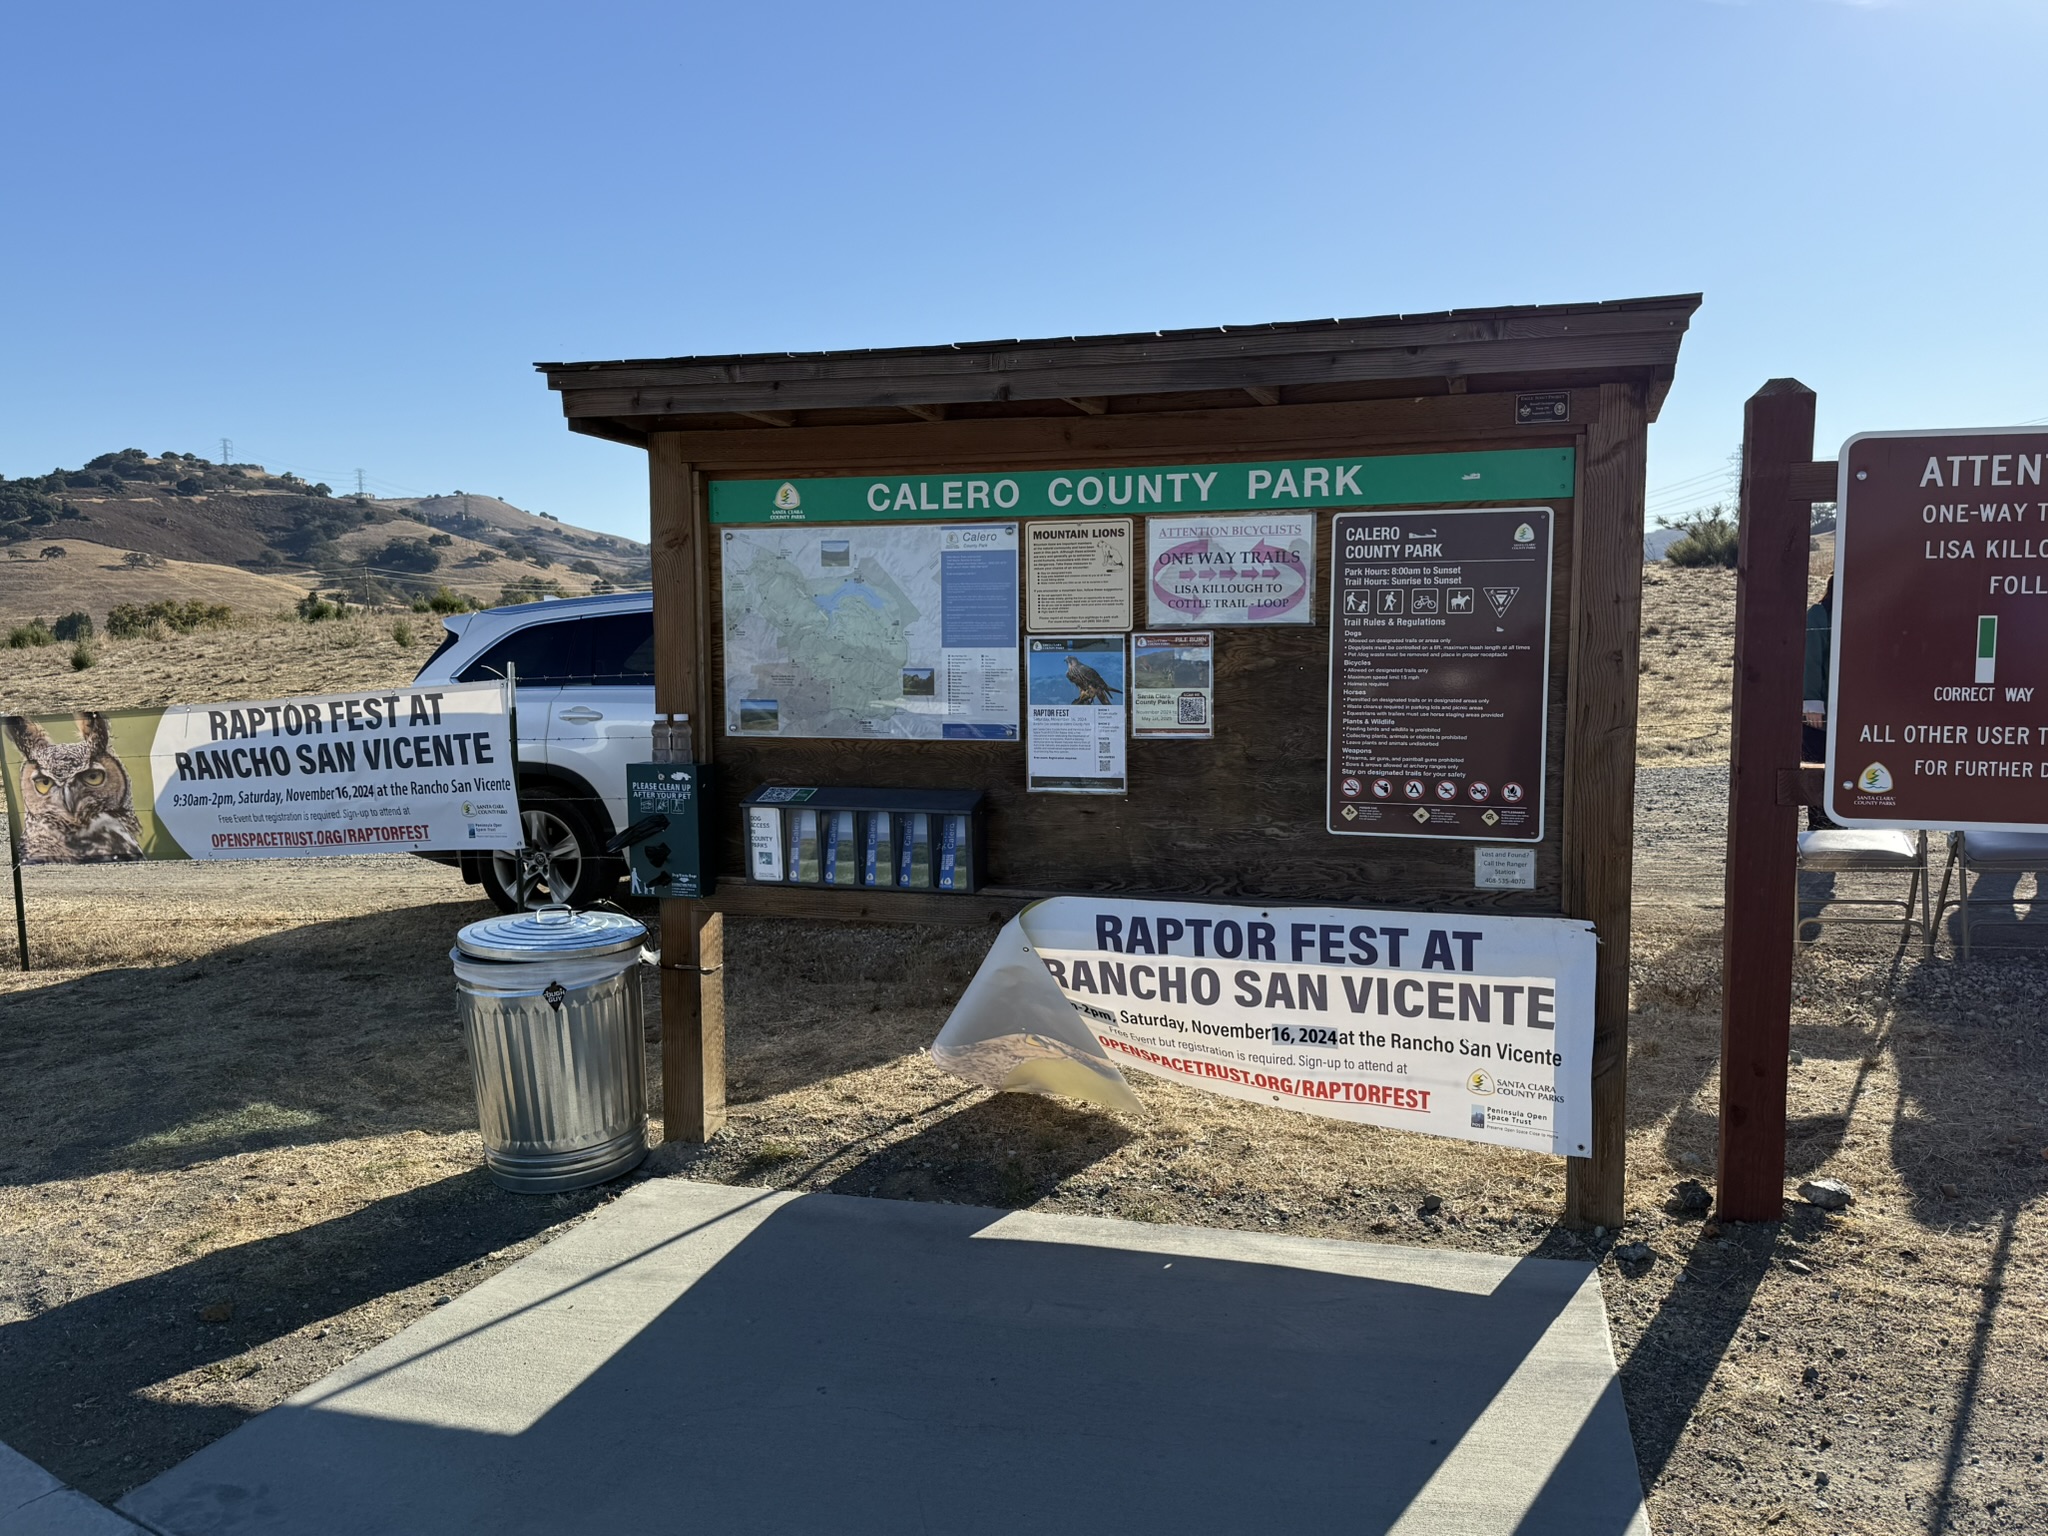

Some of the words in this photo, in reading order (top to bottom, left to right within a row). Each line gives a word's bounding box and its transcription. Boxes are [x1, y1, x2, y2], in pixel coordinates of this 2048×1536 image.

[1919, 453, 2048, 487] ATTEN
[867, 479, 1019, 511] CALERO
[1048, 471, 1218, 506] COUNTY
[1248, 465, 1363, 499] PARK
[1922, 503, 2027, 523] ONE-WAY
[962, 532, 997, 542] Calero
[1033, 529, 1088, 540] MOUNTAIN
[1092, 528, 1124, 538] LIONS
[1159, 527, 1228, 538] ATTENTION
[1232, 524, 1302, 536] BICYCLISTS
[1346, 526, 1400, 541] CALERO
[1159, 552, 1193, 565] ONE
[1198, 552, 1236, 564] WAY
[1240, 550, 1300, 563] TRAILS
[1345, 544, 1400, 558] COUNTY
[1405, 543, 1442, 557] PARK
[1925, 540, 1975, 559] LISA
[1344, 567, 1362, 576] Park
[1364, 567, 1389, 575] Hours:
[1391, 567, 1421, 575] 8:00am
[1433, 566, 1461, 574] Sunset
[1175, 585, 1198, 594] LISA
[1202, 584, 1262, 594] KILLOUGH
[1266, 583, 1282, 592] TO
[1344, 577, 1362, 585] Trail
[1364, 577, 1389, 585] Hours:
[1391, 577, 1421, 585] Sunrise
[1433, 576, 1461, 584] Sunset
[1168, 599, 1210, 609] COTTLE
[1213, 599, 1248, 608] TRAIL
[1257, 598, 1289, 608] LOOP
[1363, 618, 1386, 626] Rules
[1396, 618, 1446, 627] Regulations
[1934, 686, 1995, 702] CORRECT
[2005, 687, 2034, 702] WAY
[208, 703, 320, 740] RAPTOR
[327, 696, 400, 733] FEST
[408, 693, 444, 726] AT
[1033, 709, 1055, 717] RAPTOR
[1055, 709, 1069, 717] FEST
[1859, 724, 1895, 742] ALL
[1904, 725, 1968, 743] OTHER
[1977, 726, 2029, 744] USER
[175, 744, 290, 781] RANCHO
[295, 741, 356, 775] SAN
[361, 731, 494, 772] VICENTE
[1914, 760, 1948, 775] FOR
[1954, 760, 2033, 777] FURTHER
[173, 792, 236, 808] 9:30am-2pm,
[238, 789, 283, 804] Saturday,
[377, 783, 388, 796] at
[390, 782, 408, 796] the
[411, 780, 449, 795] Rancho
[451, 779, 471, 793] San
[474, 777, 511, 791] Vicente
[632, 782, 657, 790] PLEASE
[658, 783, 680, 791] CLEAN
[211, 825, 430, 848] OPENSPACETRUST.ORG/RAPTORFEST
[868, 819, 876, 844] Calero
[904, 820, 912, 846] Calero
[1095, 913, 1276, 960] RAPTOR
[1290, 921, 1408, 966] FEST
[1420, 930, 1482, 972] AT
[1042, 957, 1221, 1006] RANCHO
[1234, 969, 1328, 1012] SAN
[1341, 974, 1555, 1030] VICENTE
[1120, 1010, 1188, 1033] Saturday,
[1339, 1031, 1354, 1046] at
[1358, 1031, 1385, 1047] the
[1391, 1033, 1454, 1053] Rancho
[1459, 1039, 1490, 1058] San
[1496, 1042, 1562, 1067] Vicente
[1109, 1026, 1128, 1040] Free
[1130, 1032, 1156, 1046] Event
[1159, 1036, 1176, 1048] but
[1178, 1039, 1234, 1059] registration
[1237, 1049, 1245, 1060] is
[1248, 1051, 1296, 1067] required.
[1298, 1055, 1341, 1070] Sign-up
[1343, 1058, 1354, 1069] to
[1358, 1059, 1393, 1073] attend
[1396, 1063, 1407, 1074] at
[1098, 1035, 1430, 1110] OPENSPACETRUST.ORG/RAPTORFEST
[1496, 1078, 1526, 1089] SANTA
[1527, 1083, 1556, 1093] CLARA
[1496, 1087, 1536, 1101] COUNTY
[1537, 1093, 1564, 1104] PARKS
[1487, 1106, 1525, 1118] Peninsula
[1527, 1112, 1548, 1121] Open
[1487, 1113, 1510, 1124] Space
[1511, 1117, 1532, 1125] Trust
